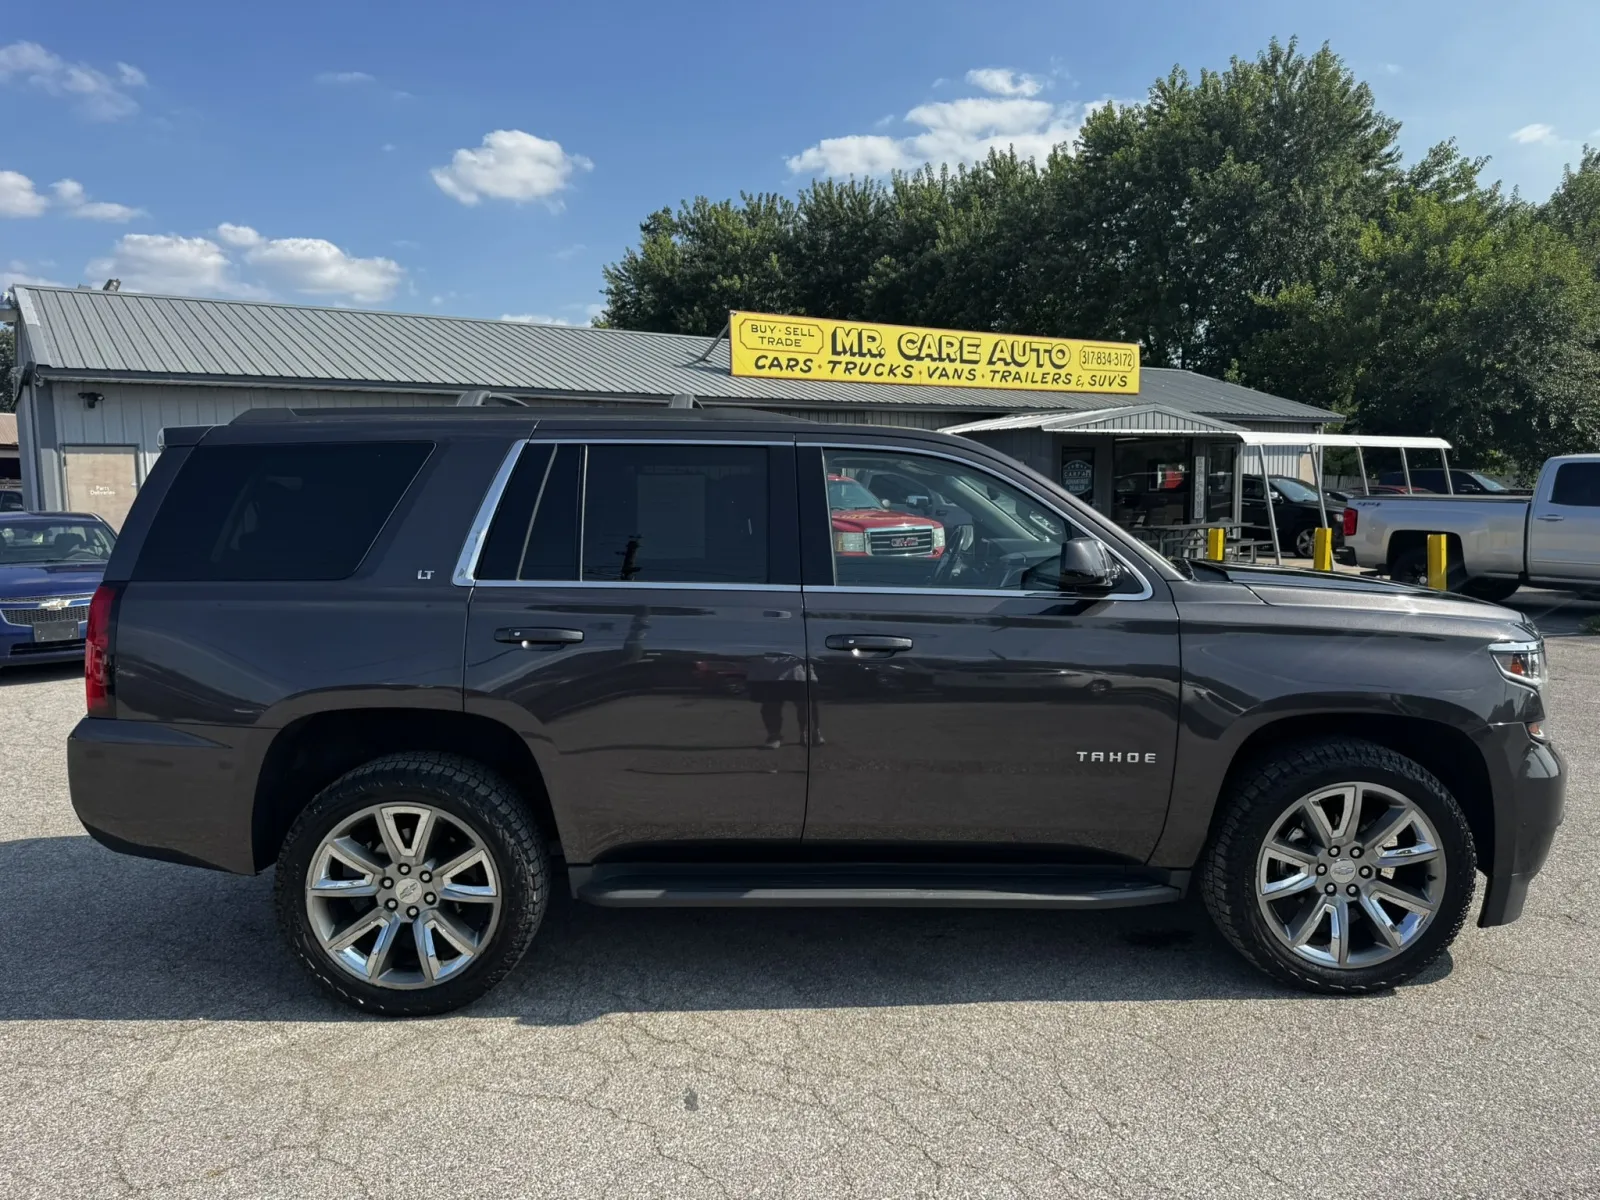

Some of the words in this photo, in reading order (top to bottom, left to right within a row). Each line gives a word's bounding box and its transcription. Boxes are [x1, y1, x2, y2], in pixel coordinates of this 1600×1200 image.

[751, 324, 776, 334] BUY
[784, 326, 815, 337] SELL
[758, 336, 802, 347] TRADE
[831, 326, 886, 358] MR.
[897, 331, 982, 365] CARE
[986, 339, 1072, 369] AUTO
[754, 355, 814, 373] CARS
[826, 360, 915, 378] TRUCKS
[926, 365, 977, 382] VANS
[989, 370, 1073, 386] TRAILERS
[1087, 374, 1128, 387] SUV'S
[417, 569, 435, 580] LT
[1076, 751, 1156, 763] TAHOE
